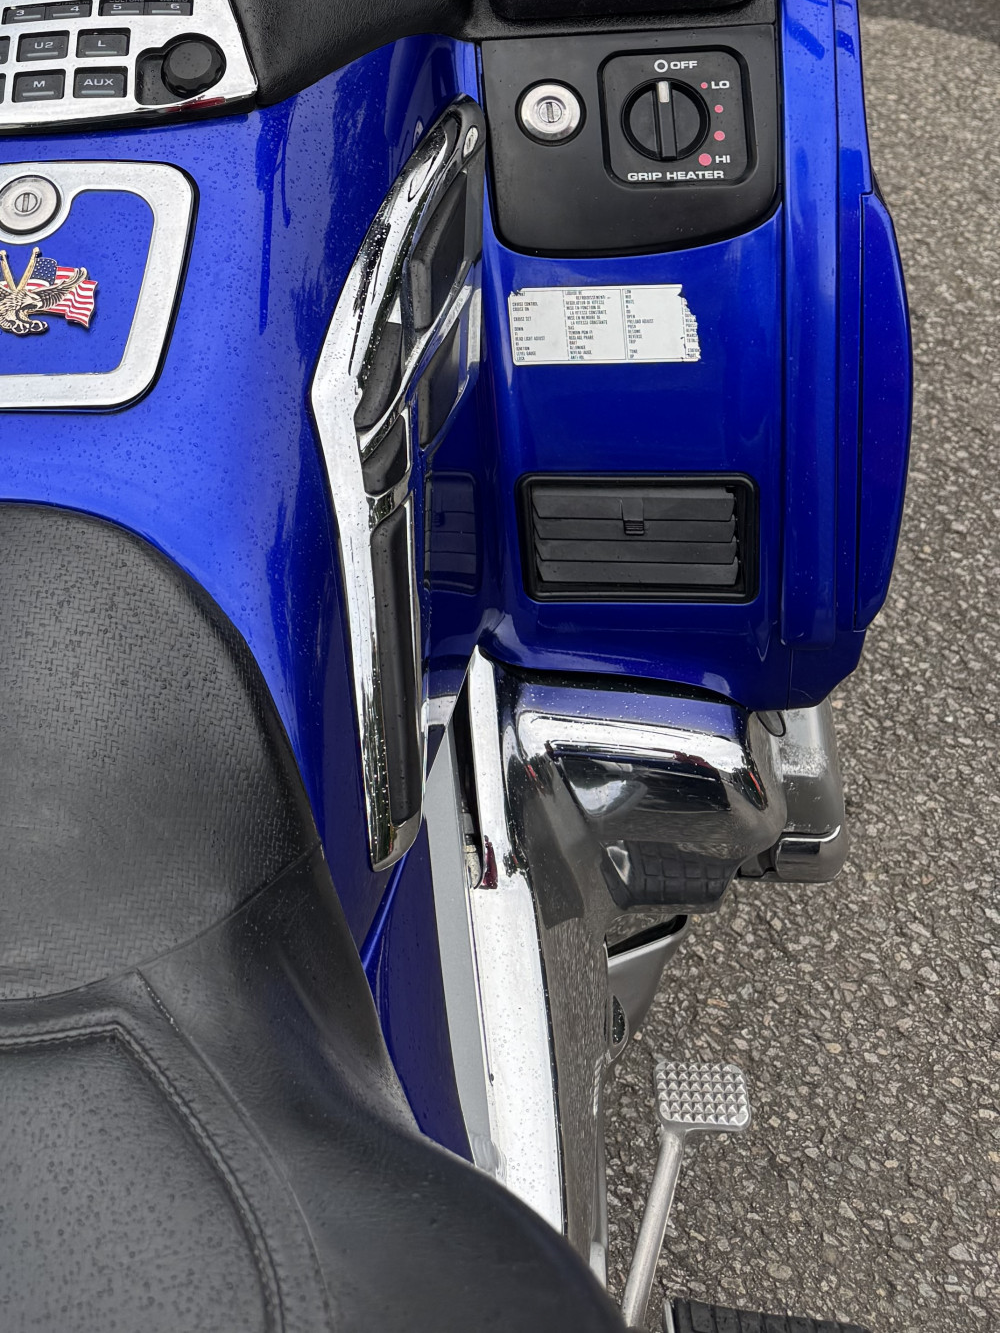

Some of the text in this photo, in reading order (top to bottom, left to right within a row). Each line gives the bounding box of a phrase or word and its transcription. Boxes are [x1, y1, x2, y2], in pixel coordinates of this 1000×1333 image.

[670, 61, 698, 69] OFF
[33, 80, 45, 88] M
[84, 78, 114, 86] AUX
[711, 81, 730, 89] LO
[715, 155, 730, 163] HI
[627, 170, 724, 181] GRIP HEATER
